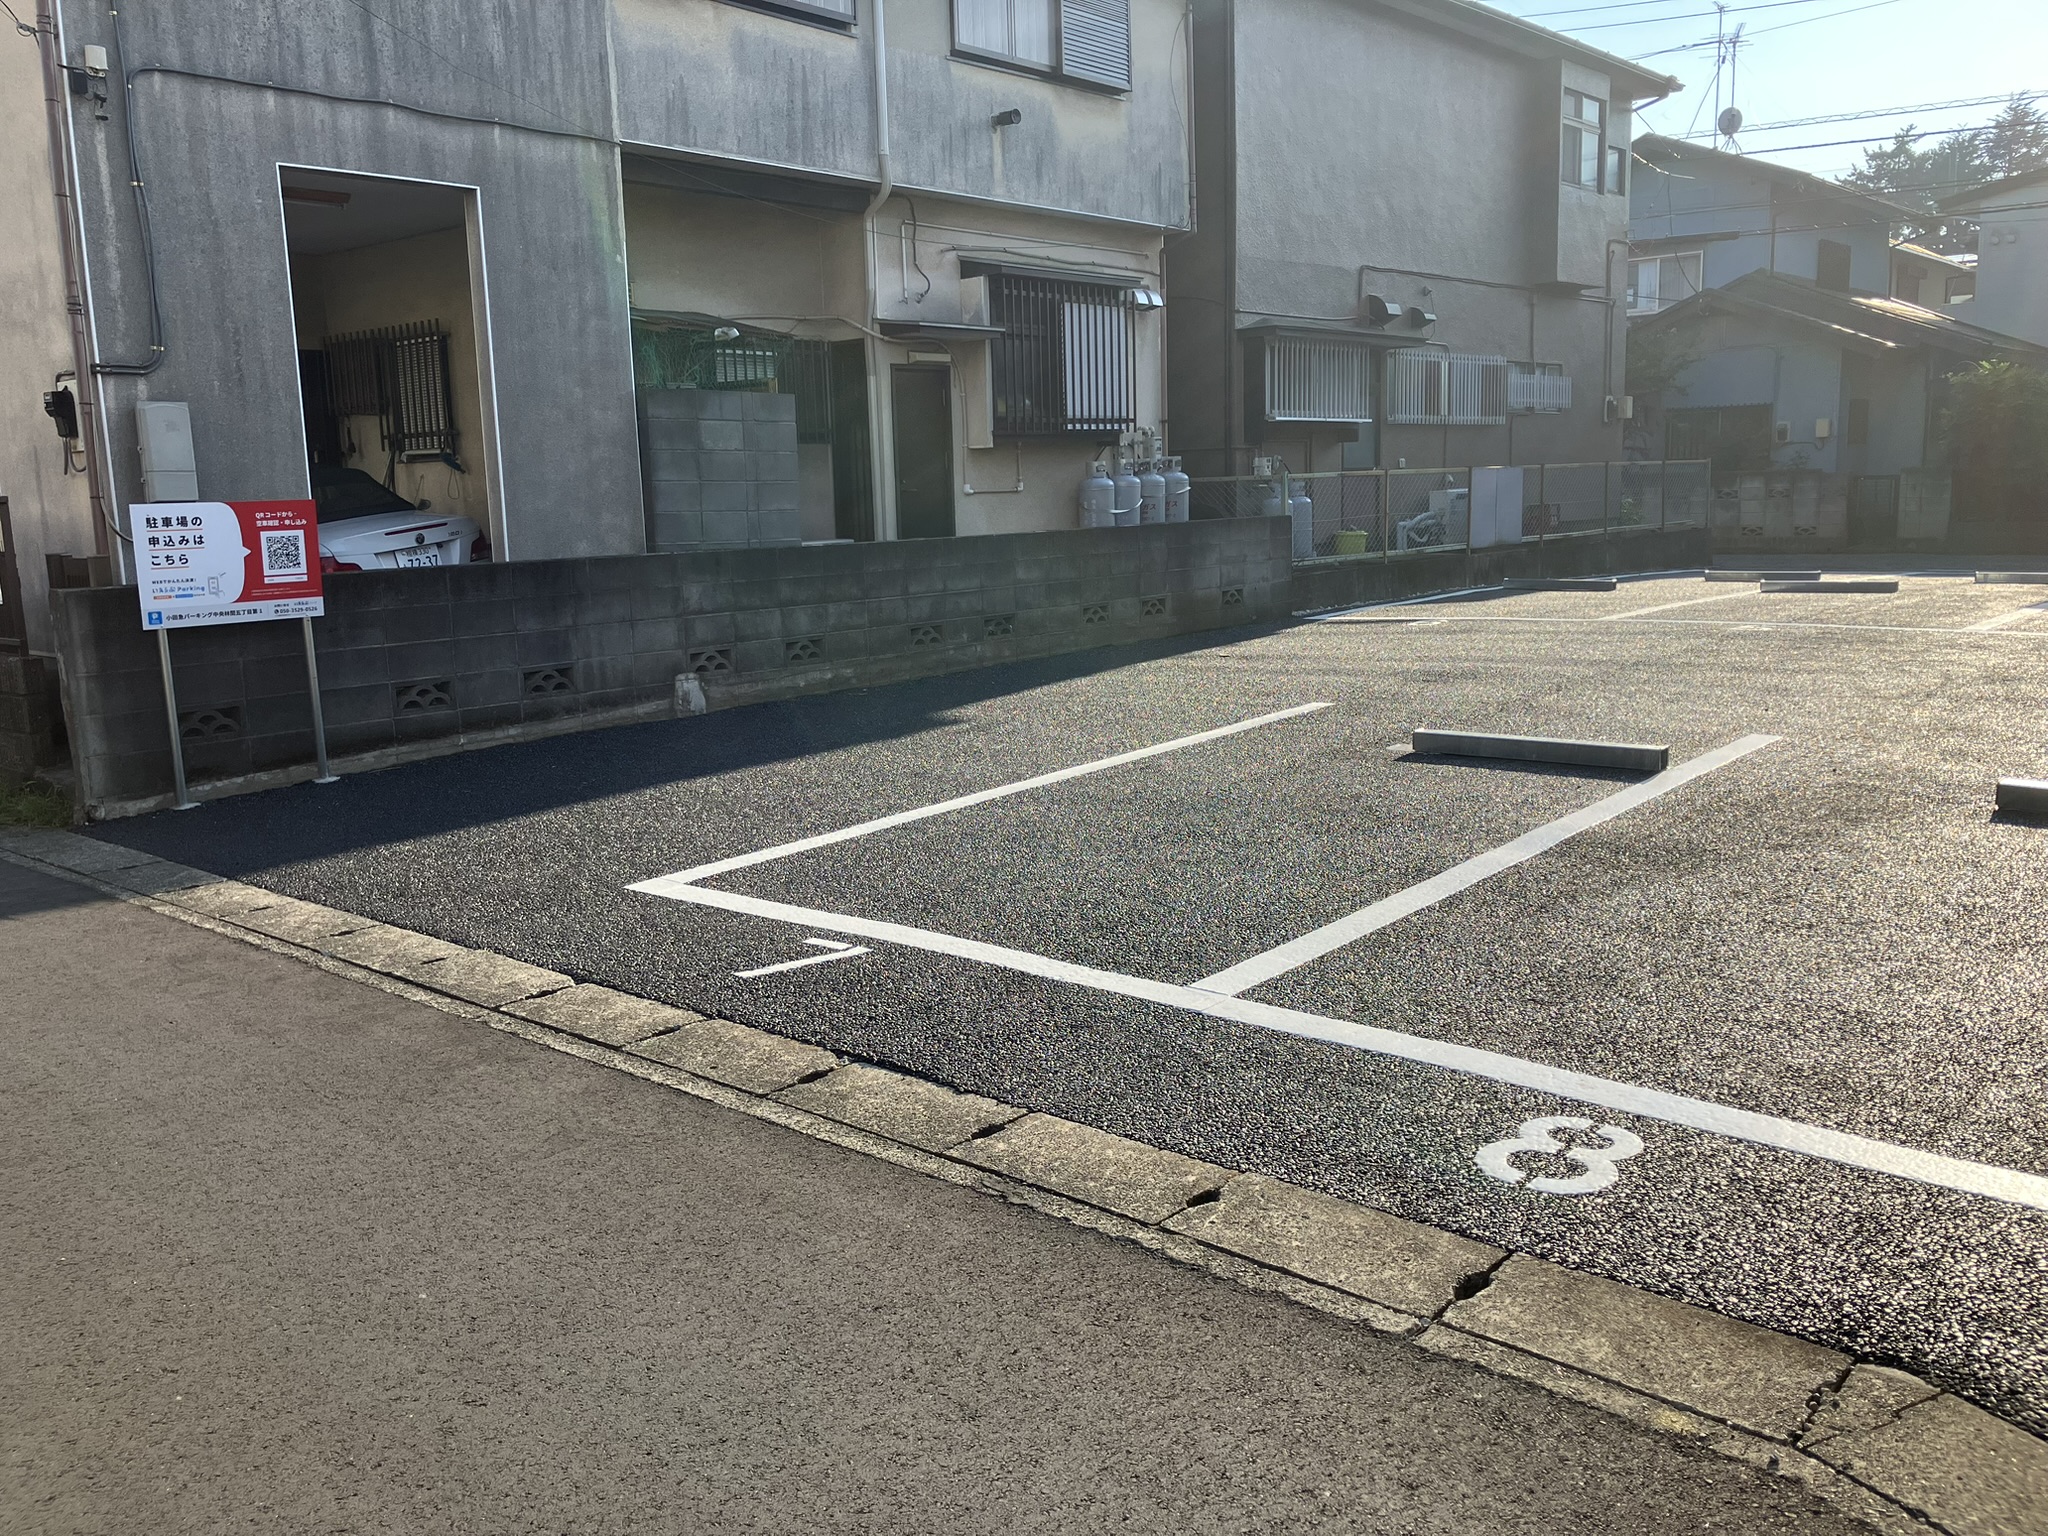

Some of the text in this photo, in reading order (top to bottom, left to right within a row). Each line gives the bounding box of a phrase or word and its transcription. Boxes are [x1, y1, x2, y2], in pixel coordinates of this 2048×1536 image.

[145, 516, 203, 529] 駐車場の
[148, 535, 205, 548] 申込みは
[151, 554, 189, 566] こちら
[734, 938, 874, 978] 7
[1474, 1116, 1644, 1195] 8
